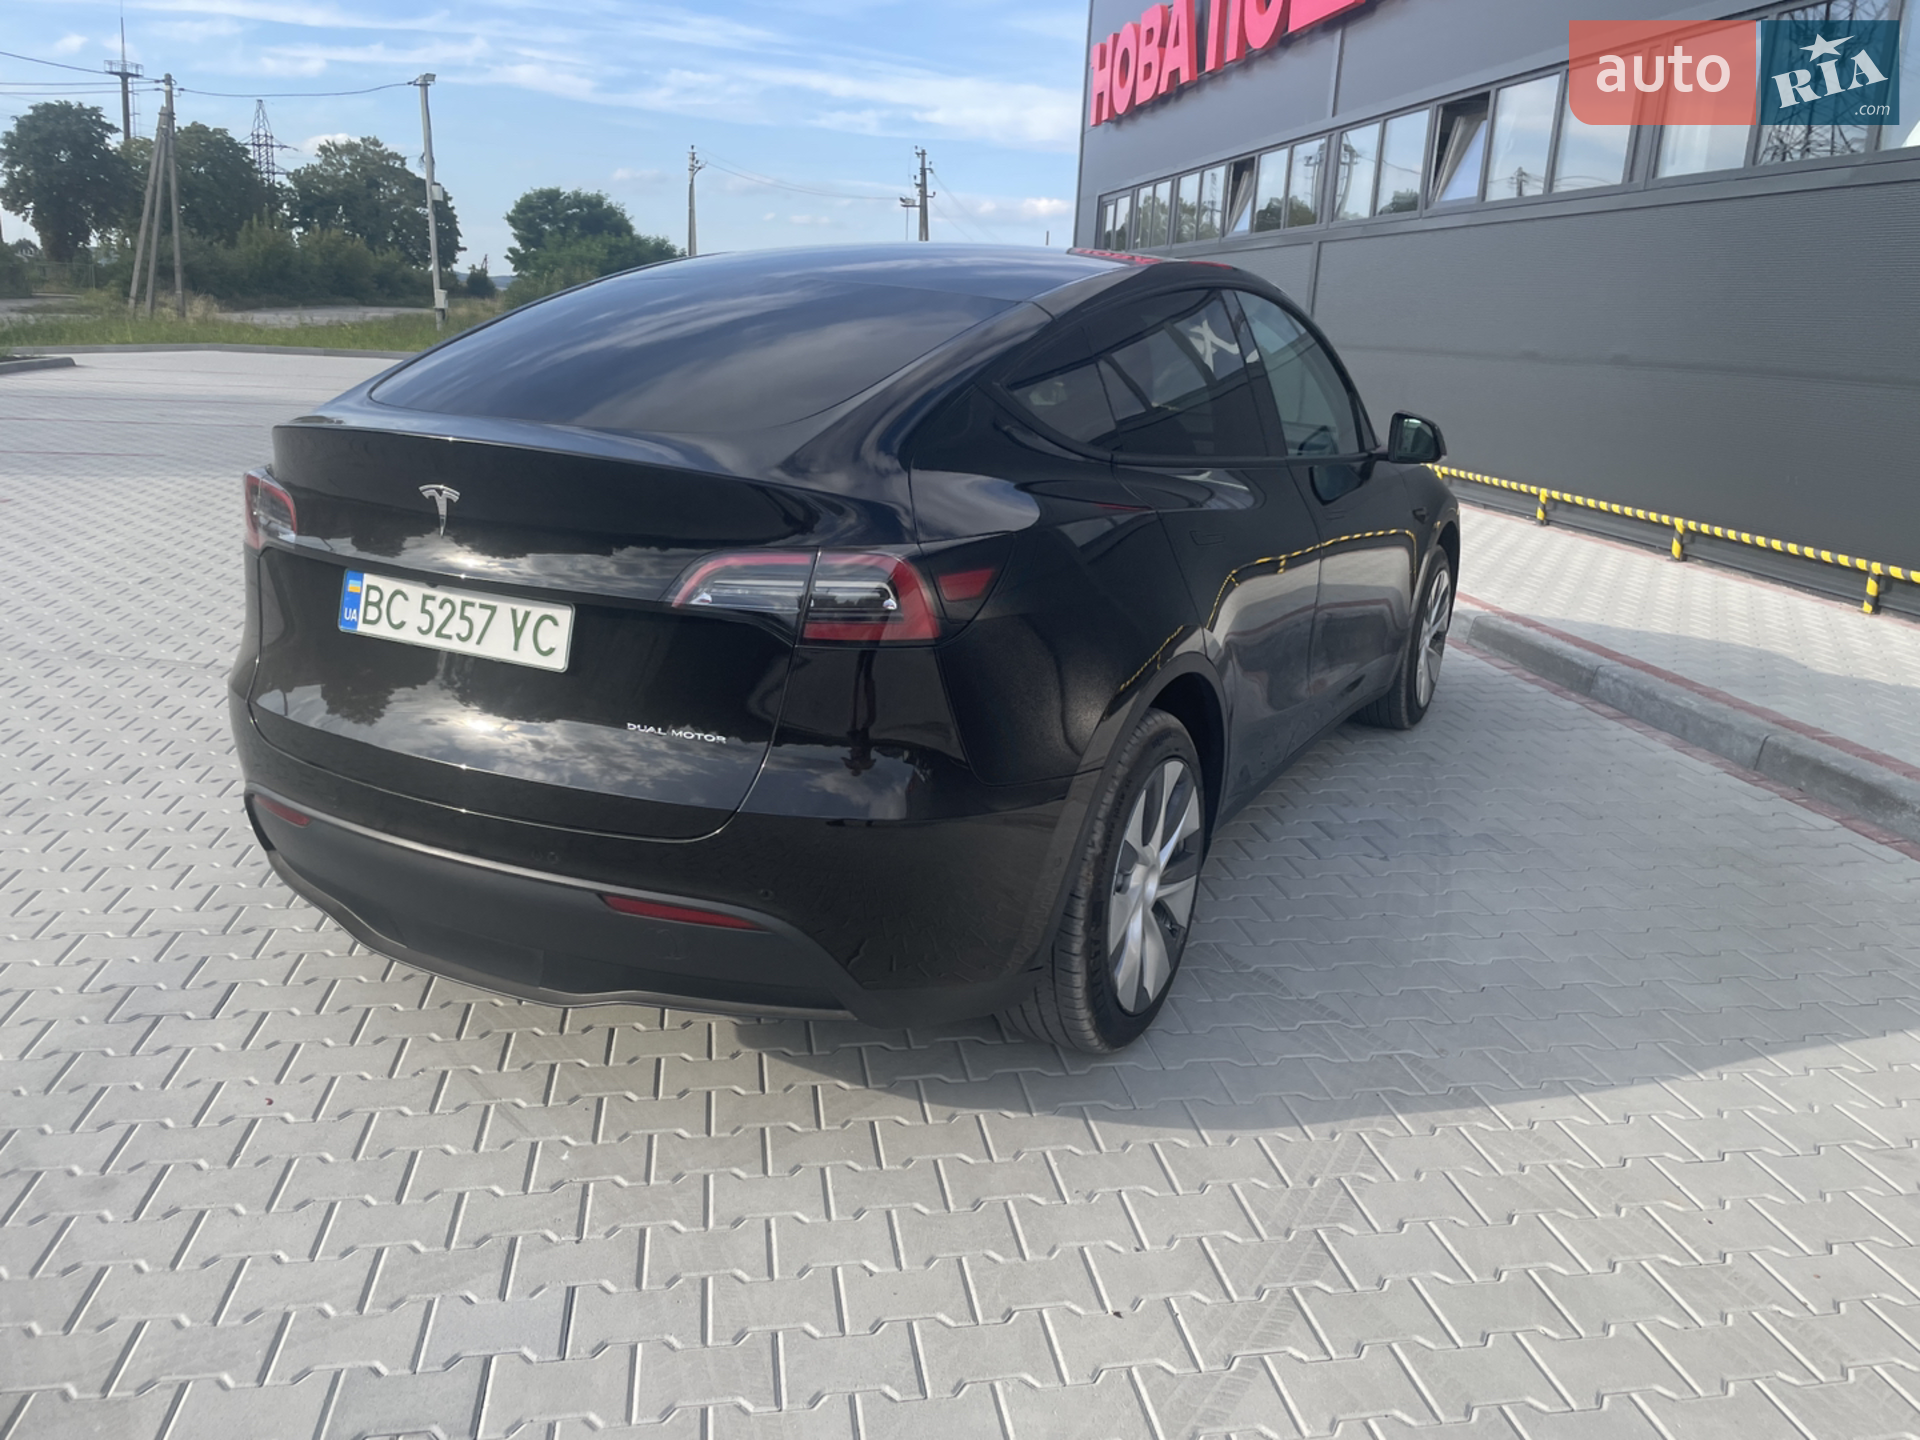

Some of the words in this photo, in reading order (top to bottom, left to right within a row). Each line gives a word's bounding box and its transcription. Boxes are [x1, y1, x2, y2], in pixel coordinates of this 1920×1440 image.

[1090, 0, 1197, 127] НОВА
[343, 607, 358, 623] UA
[361, 584, 409, 630] BC
[416, 593, 497, 645] 5257
[510, 607, 560, 657] YC
[626, 722, 667, 736] DUAL
[671, 729, 727, 745] MOTOR
